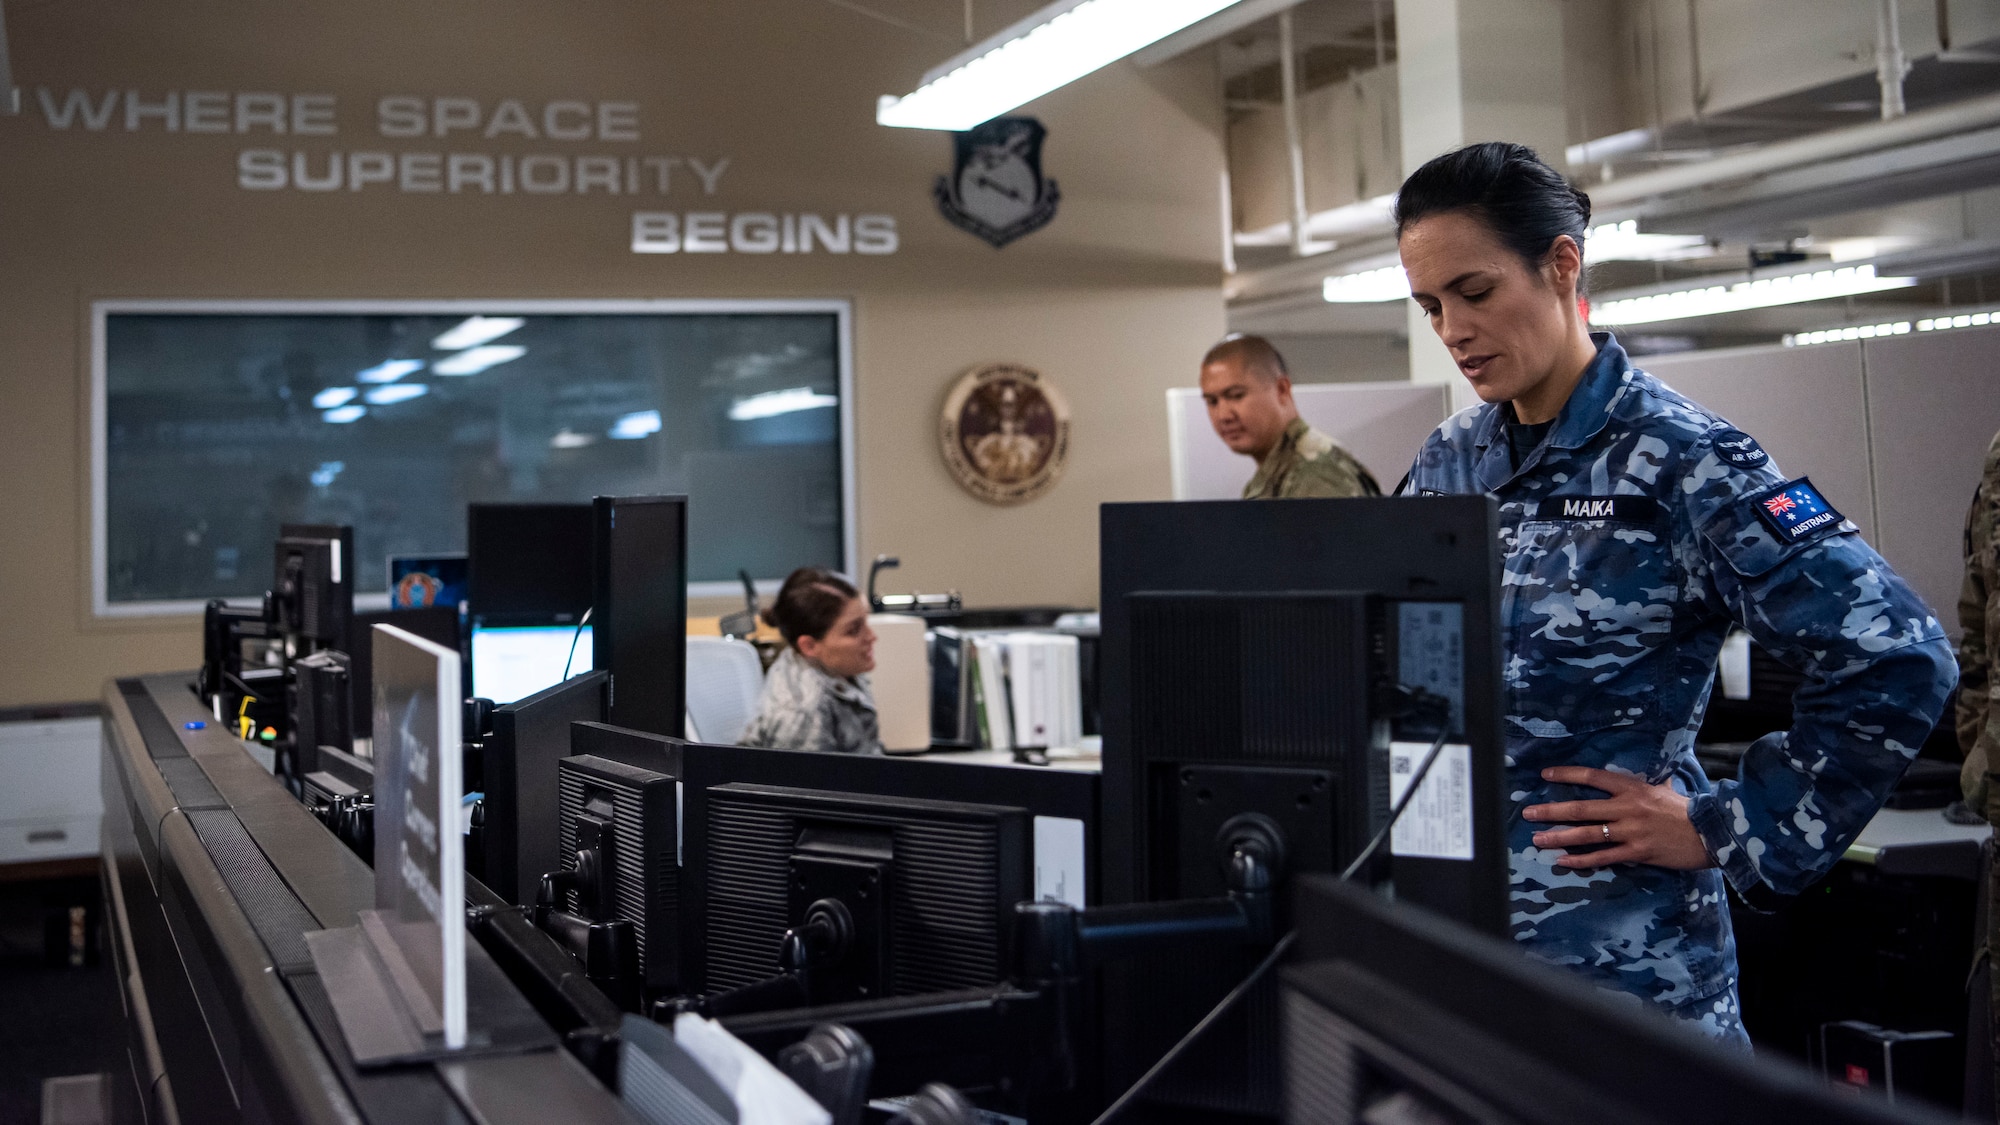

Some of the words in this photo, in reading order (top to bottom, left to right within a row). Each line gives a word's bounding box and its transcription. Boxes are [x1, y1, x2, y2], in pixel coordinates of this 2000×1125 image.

[36, 87, 338, 134] WHERE
[377, 96, 640, 141] SPACE
[237, 149, 730, 195] SUPERIORITY
[630, 211, 899, 254] BEGINS
[1732, 454, 1745, 462] AIR
[1747, 449, 1765, 461] FORCE
[1563, 499, 1614, 518] MAIKA
[1790, 512, 1834, 537] AUSTRALIA
